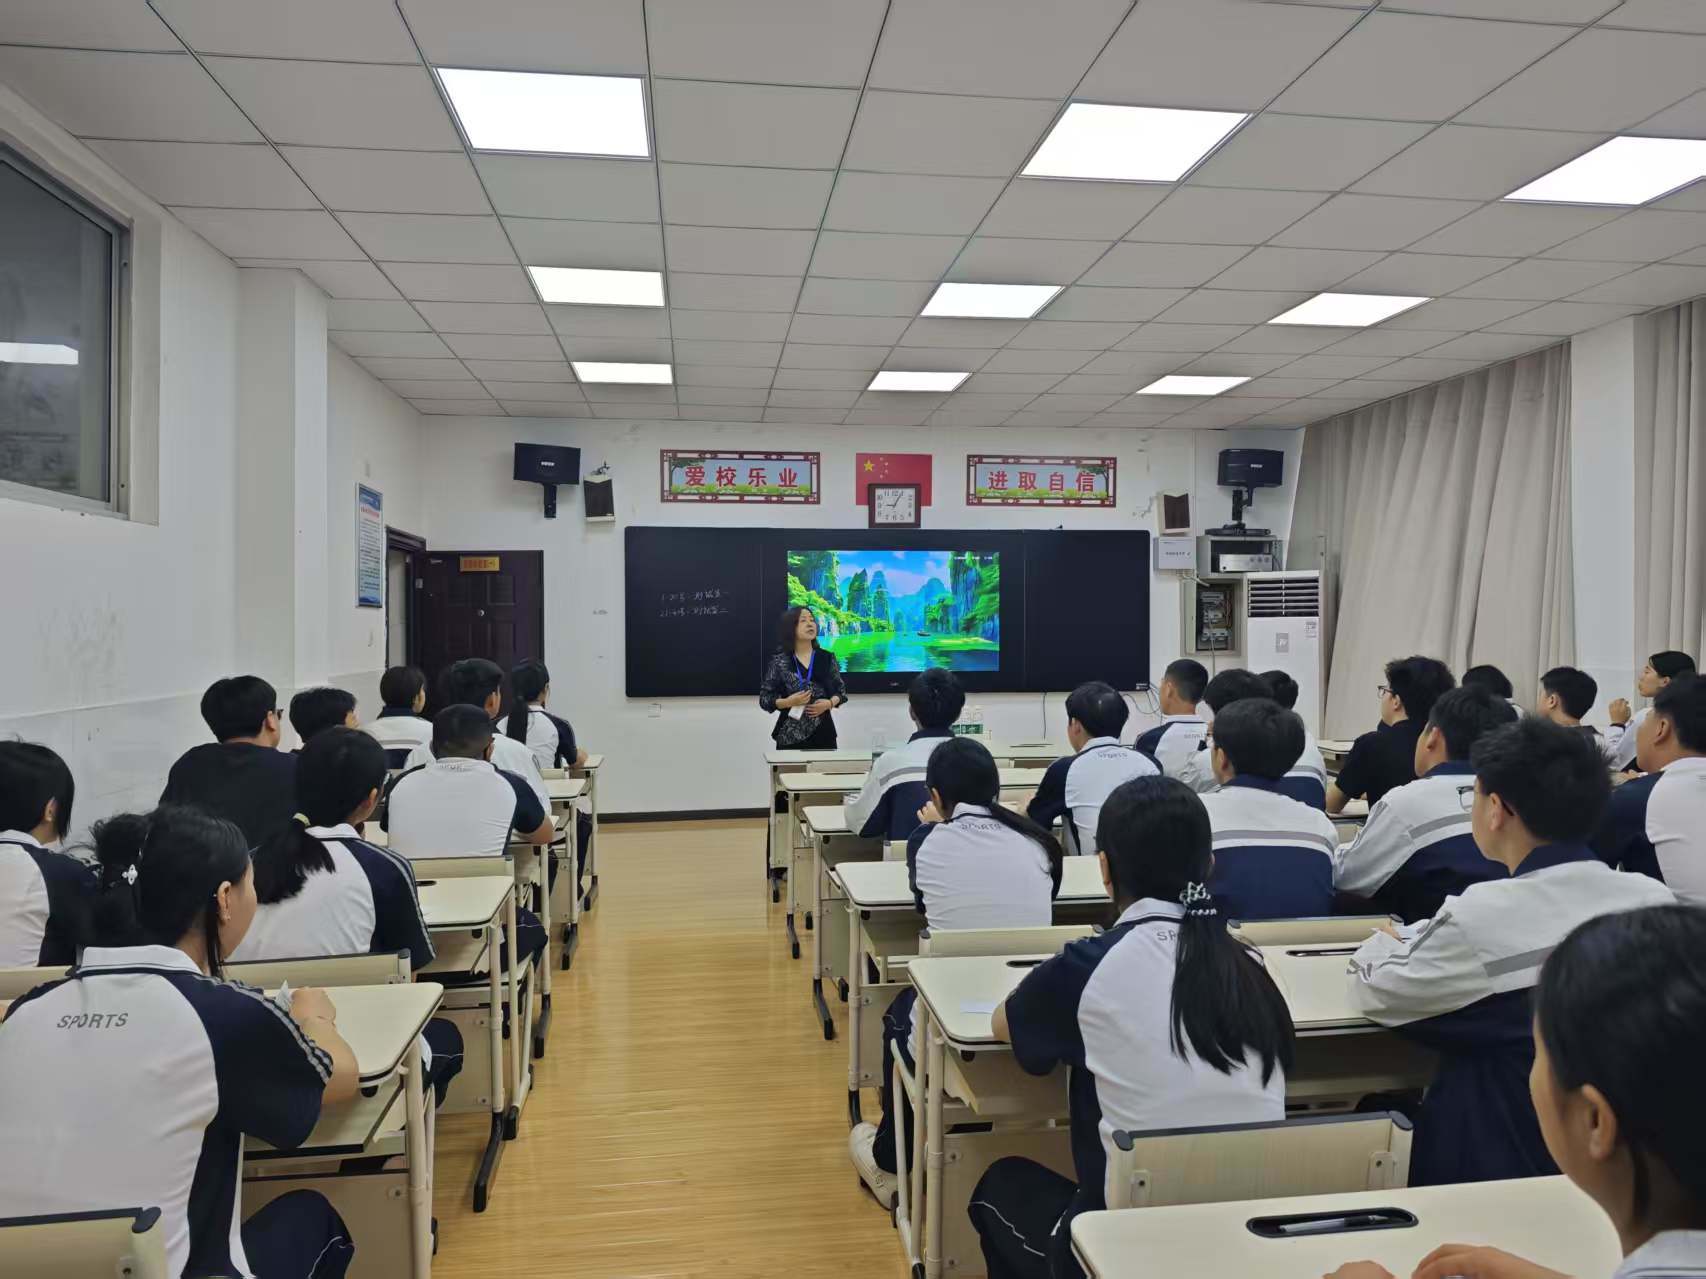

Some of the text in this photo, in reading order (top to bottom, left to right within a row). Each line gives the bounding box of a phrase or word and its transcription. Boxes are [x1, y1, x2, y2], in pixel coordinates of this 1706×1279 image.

[685, 465, 798, 488] 爱校乐业
[988, 470, 1095, 492] 进取自信
[57, 1013, 129, 1029] SPORTS
